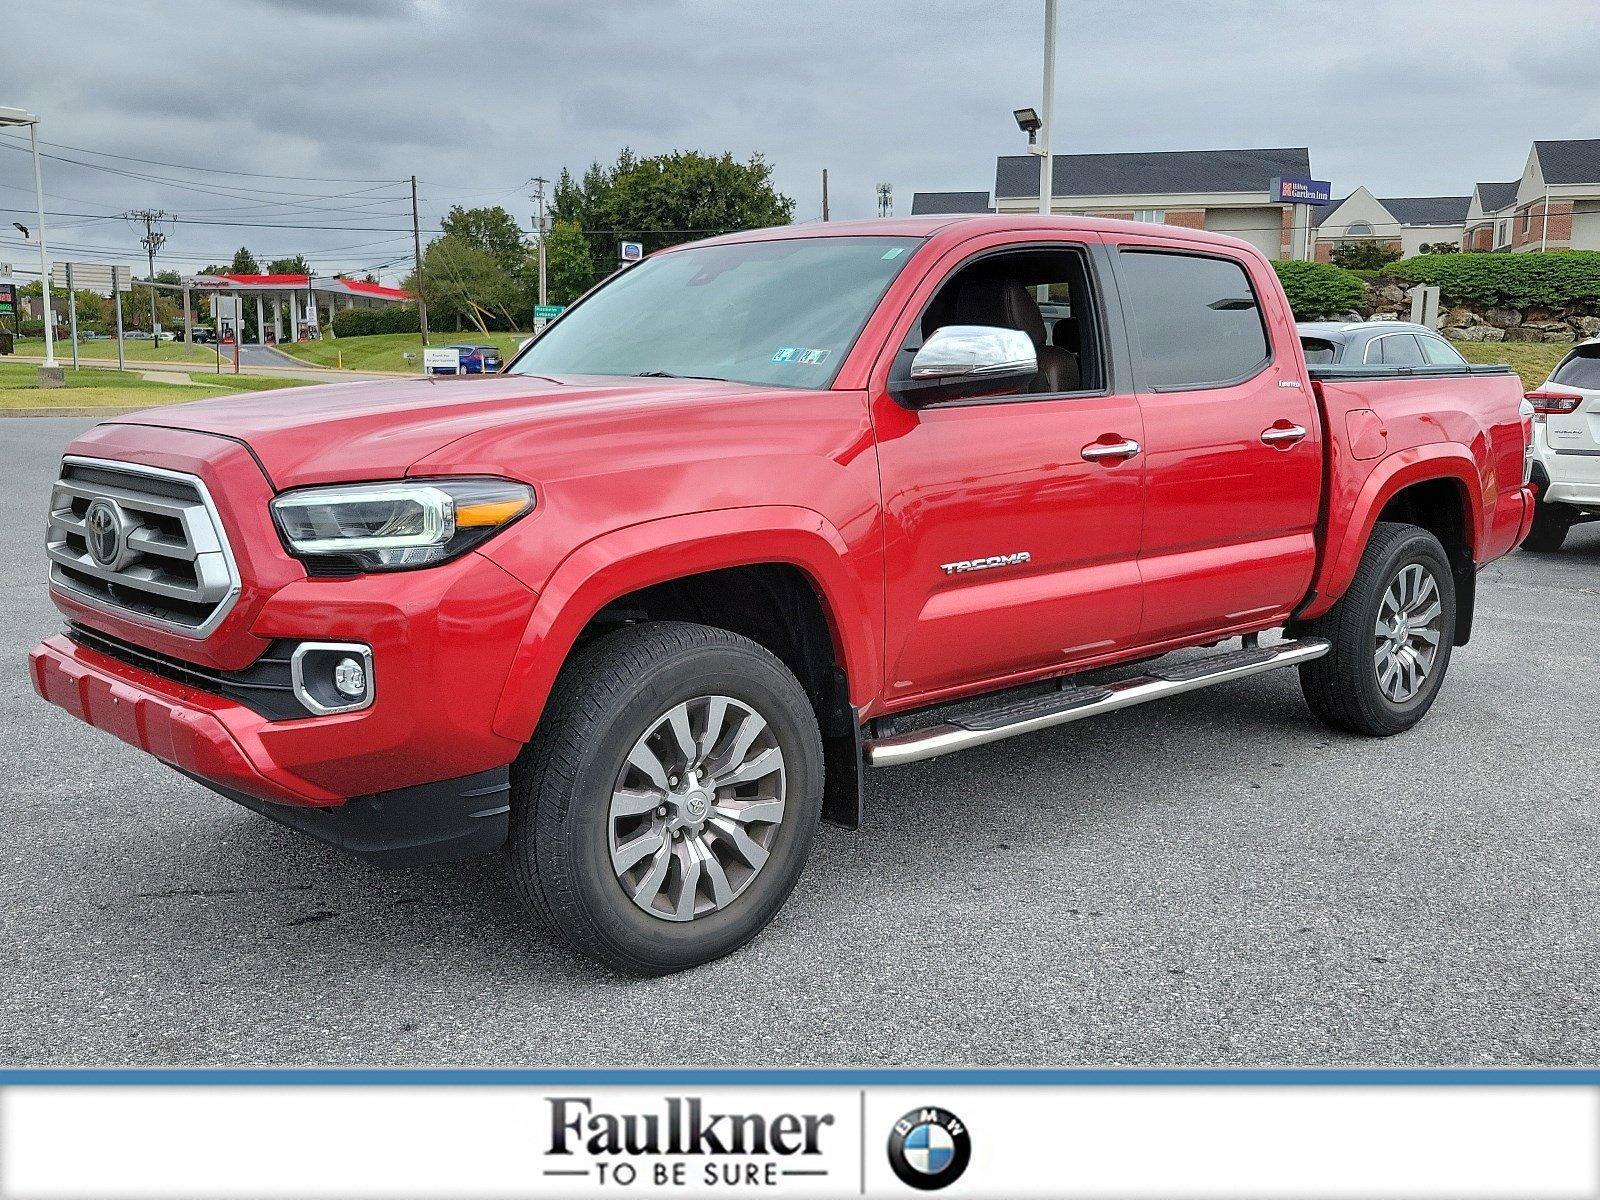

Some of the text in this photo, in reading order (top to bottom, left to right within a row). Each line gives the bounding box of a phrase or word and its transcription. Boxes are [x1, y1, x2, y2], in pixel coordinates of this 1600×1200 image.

[1291, 189, 1328, 200] Garden Inn
[940, 551, 1031, 575] TACOMA
